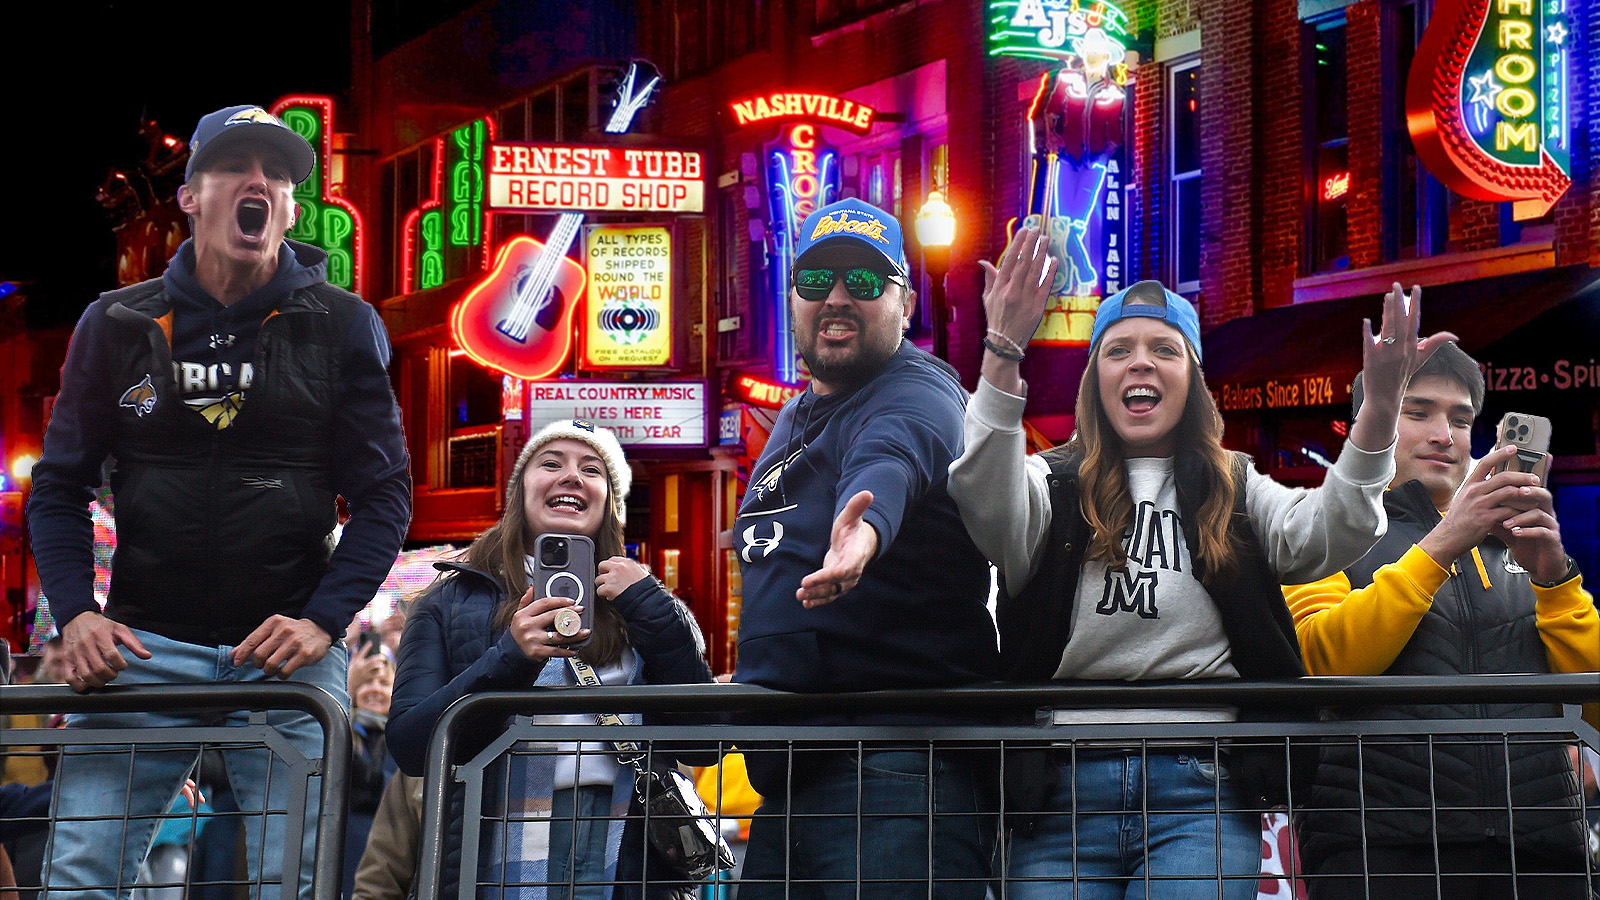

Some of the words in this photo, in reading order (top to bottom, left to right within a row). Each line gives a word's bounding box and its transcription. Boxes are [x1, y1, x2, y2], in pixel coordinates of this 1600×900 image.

[1548, 52, 1560, 138] PIZZA
[733, 92, 873, 129] NASHVILLE
[492, 146, 610, 175] ERNEST
[625, 150, 701, 178] TUBB
[508, 180, 610, 206] RECORD
[622, 183, 687, 208] SHOP
[1106, 159, 1120, 220] ALAN
[597, 235, 618, 245] ALL
[626, 234, 663, 245] TYPES
[811, 213, 890, 245] Bobcats
[591, 247, 607, 258] OF
[613, 247, 668, 257] RECORDS
[605, 260, 655, 270] SHIPPED
[1106, 233, 1121, 294] JACK
[594, 272, 635, 283] ROUND
[643, 271, 664, 282] THE
[598, 285, 661, 301] WORLD
[535, 388, 574, 400] REAL
[578, 387, 648, 400] COUNTRY
[652, 387, 696, 400] MUSIC
[1223, 383, 1262, 410] Bakers
[1266, 380, 1299, 408] Since
[1303, 376, 1333, 406] 1974
[574, 407, 618, 419] LIVES
[624, 407, 662, 419] HERE
[643, 425, 681, 438] YEAR
[1096, 567, 1159, 619] M
